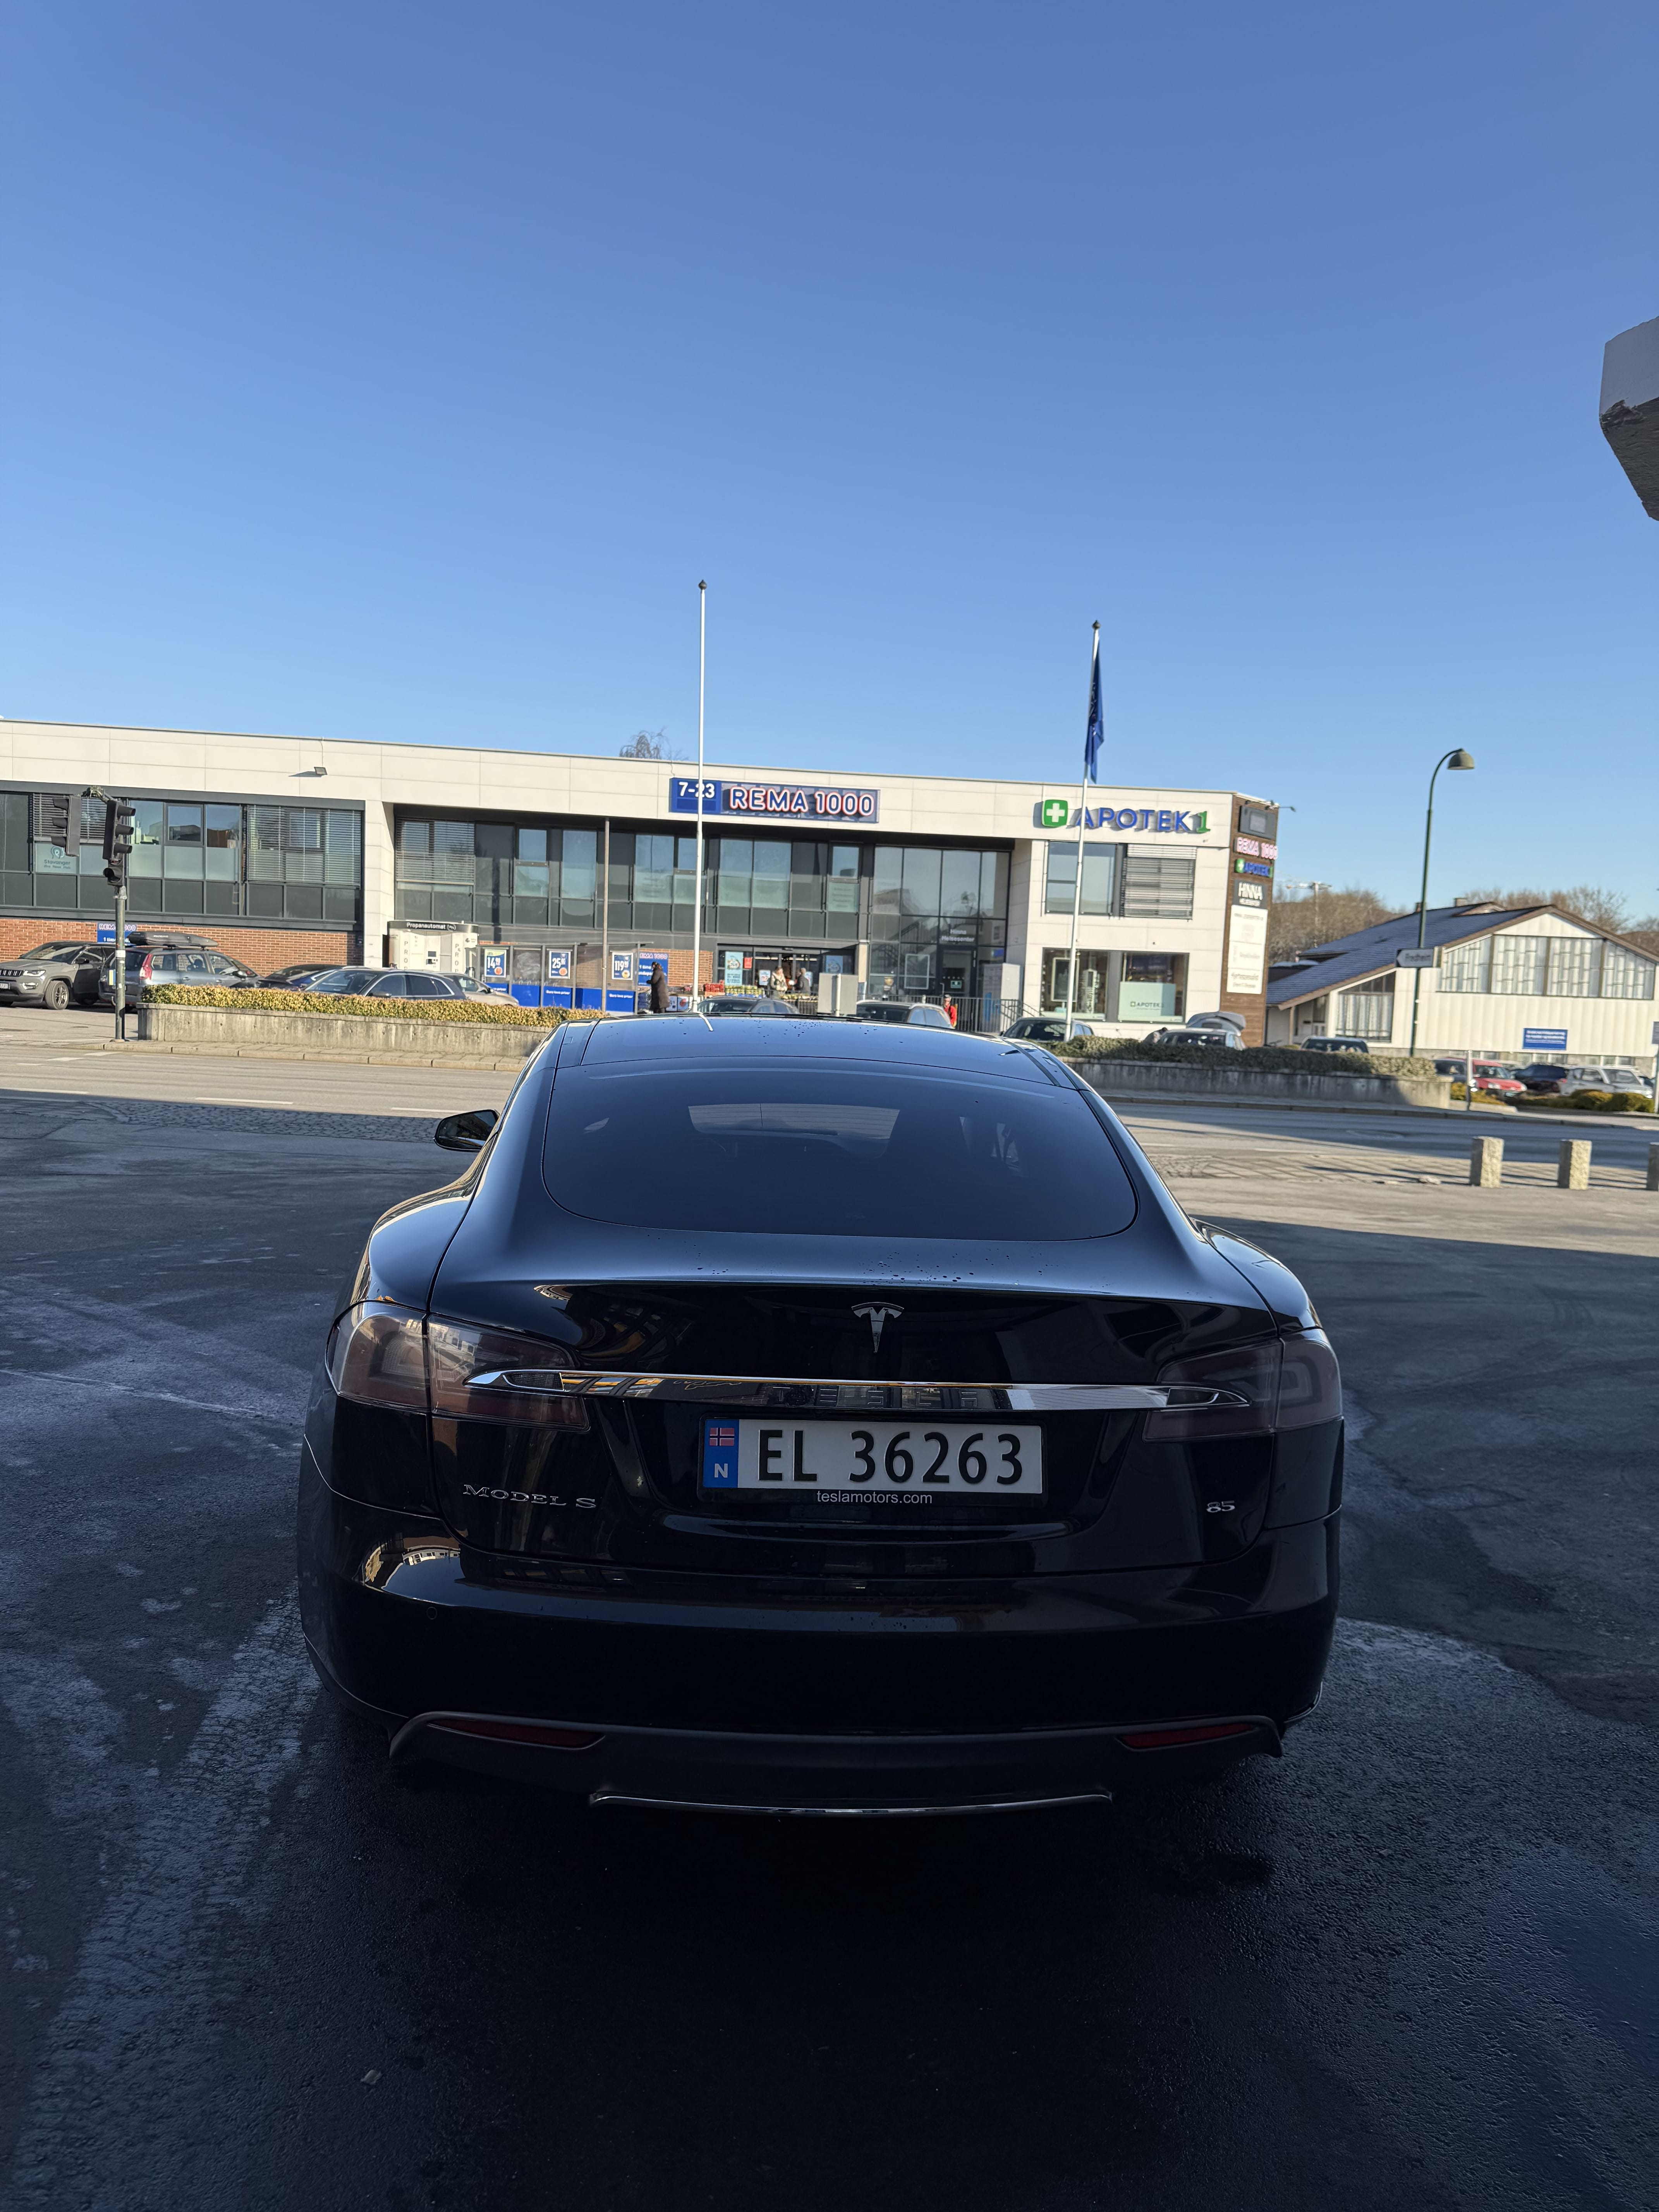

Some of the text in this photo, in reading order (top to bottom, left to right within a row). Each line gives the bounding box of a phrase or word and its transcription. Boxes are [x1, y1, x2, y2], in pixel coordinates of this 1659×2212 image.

[679, 781, 715, 798] 7-23
[730, 787, 874, 815] REMA 1000
[1076, 807, 1211, 833] APOTEK 1
[1237, 837, 1278, 860] REMA 1000
[1245, 862, 1269, 876] APOTEK
[1238, 882, 1263, 900] HINNA
[488, 957, 496, 969] 14
[552, 958, 561, 969] 25
[615, 960, 624, 971] 119
[759, 1429, 1023, 1485] EL 36263
[714, 1463, 728, 1478] N
[463, 1484, 596, 1508] MODEL S
[817, 1491, 932, 1503] teslamotors.com
[1206, 1500, 1235, 1513] 85
